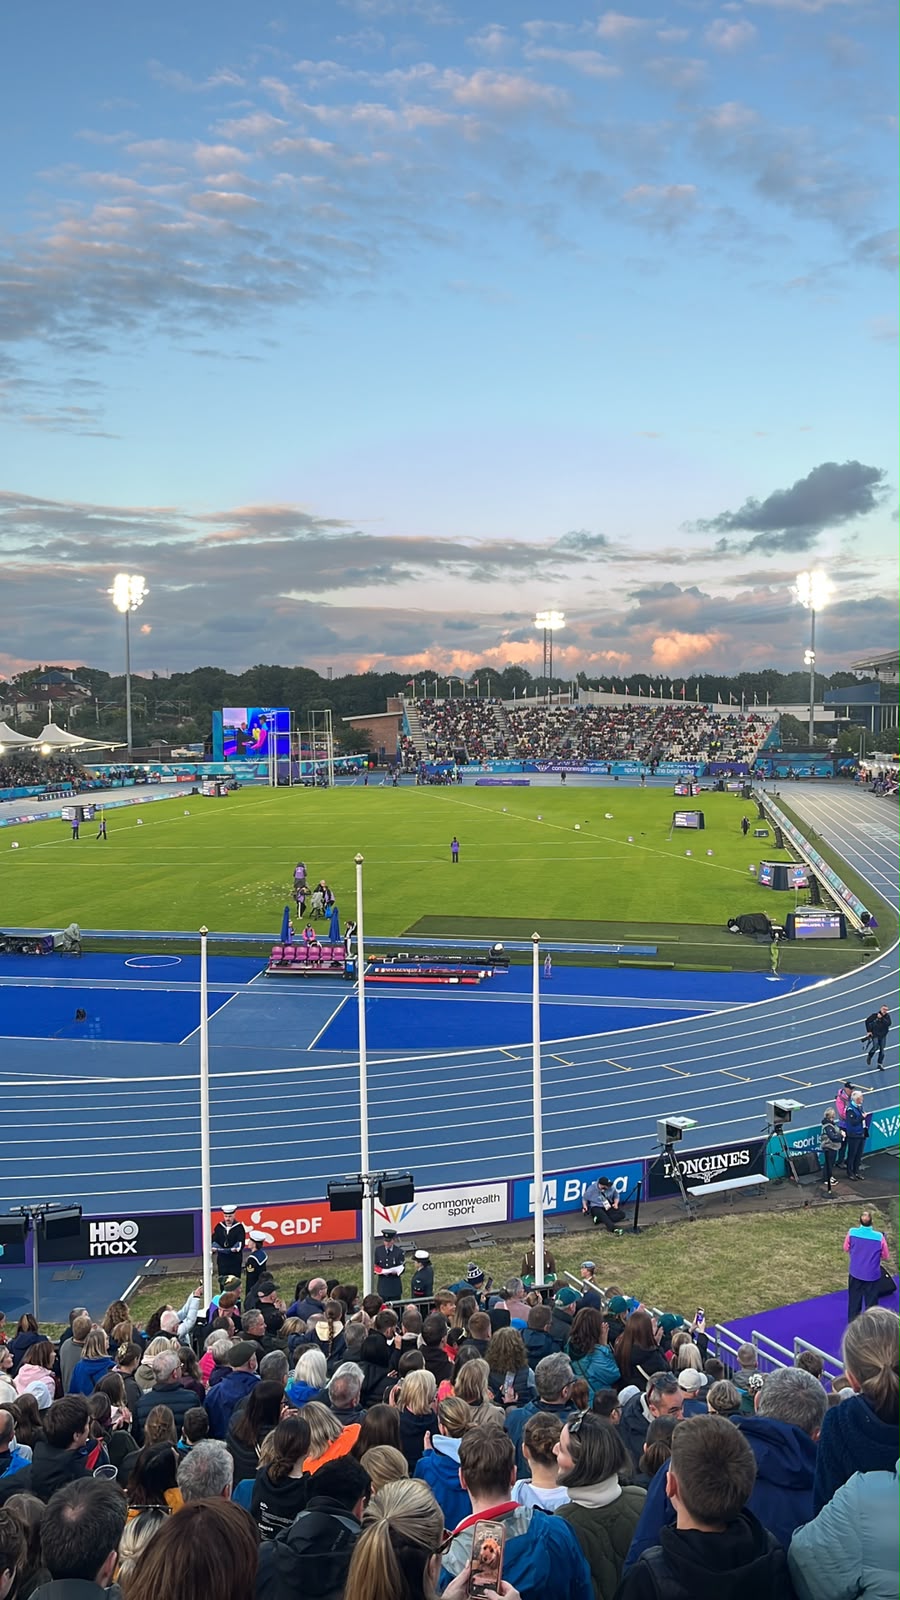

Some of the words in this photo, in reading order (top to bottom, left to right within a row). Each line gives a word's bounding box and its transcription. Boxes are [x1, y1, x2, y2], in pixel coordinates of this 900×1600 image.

[591, 766, 608, 774] games
[624, 767, 639, 775] sport
[666, 767, 694, 775] beginning
[793, 1135, 815, 1149] sport
[663, 1149, 750, 1178] LONGINES
[422, 1193, 500, 1211] commonwealth
[448, 1205, 475, 1217] sport
[89, 1220, 139, 1242] HBO
[90, 1240, 137, 1256] max
